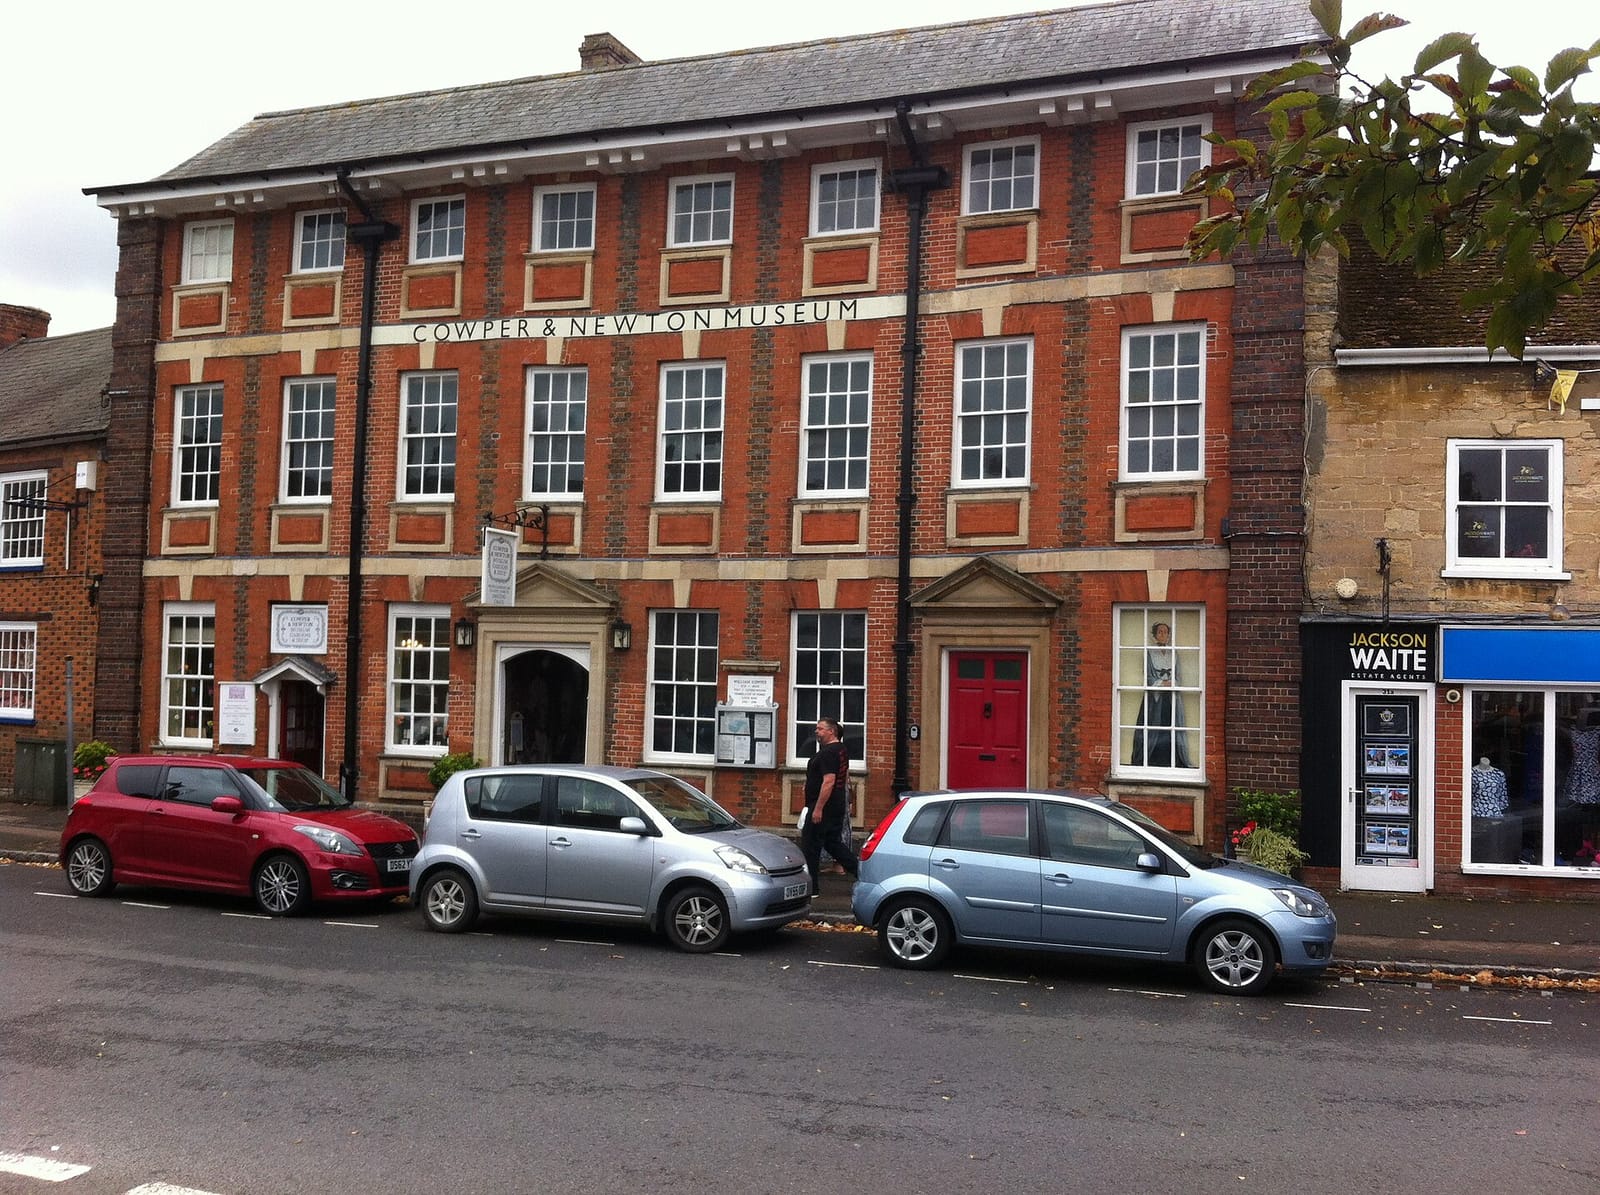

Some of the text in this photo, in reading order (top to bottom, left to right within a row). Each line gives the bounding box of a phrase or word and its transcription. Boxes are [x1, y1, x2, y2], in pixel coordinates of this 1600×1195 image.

[413, 299, 857, 342] COWPER & NEWTON MUSEUM
[1349, 632, 1427, 648] JACKSON
[1349, 647, 1427, 671] WAITE
